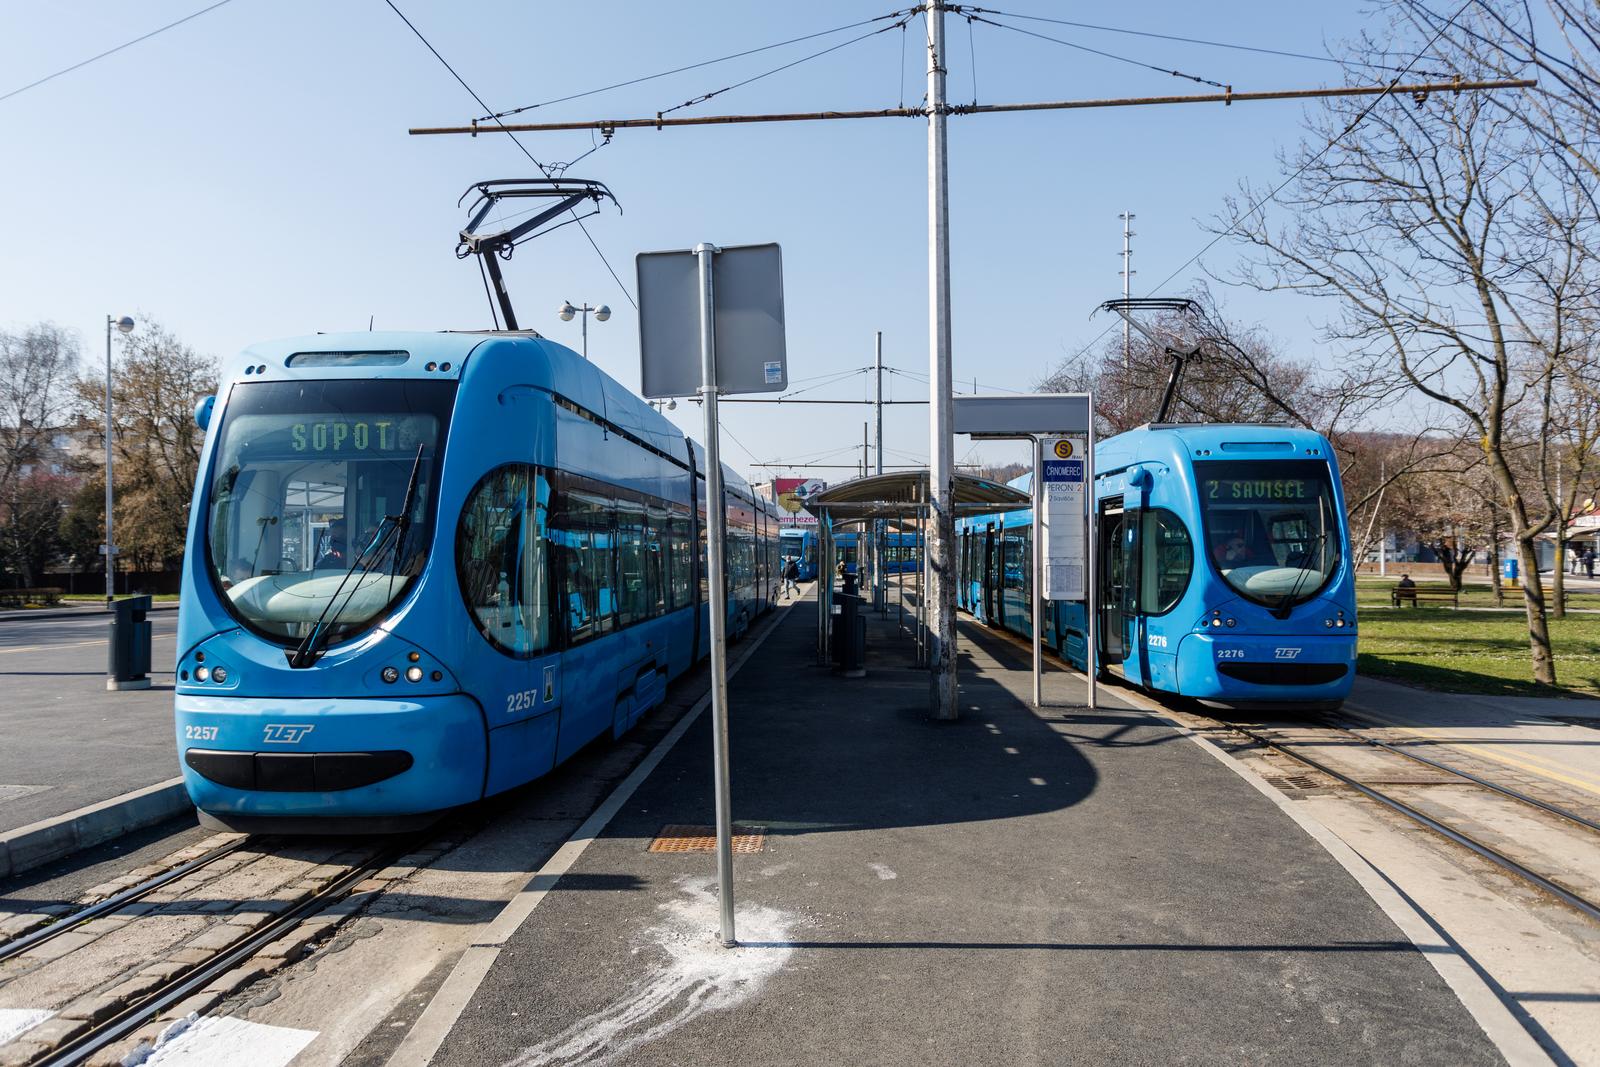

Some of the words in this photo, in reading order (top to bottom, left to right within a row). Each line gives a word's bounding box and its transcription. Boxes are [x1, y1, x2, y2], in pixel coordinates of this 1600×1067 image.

[291, 422, 391, 451] SOPOT
[1059, 443, 1069, 455] S
[1208, 481, 1218, 498] 2
[1148, 634, 1167, 648] 2276
[1217, 650, 1244, 658] 2276
[1275, 647, 1302, 659] ZET
[506, 689, 537, 713] 2257
[185, 725, 219, 741] 2257
[263, 724, 315, 743] ZET
